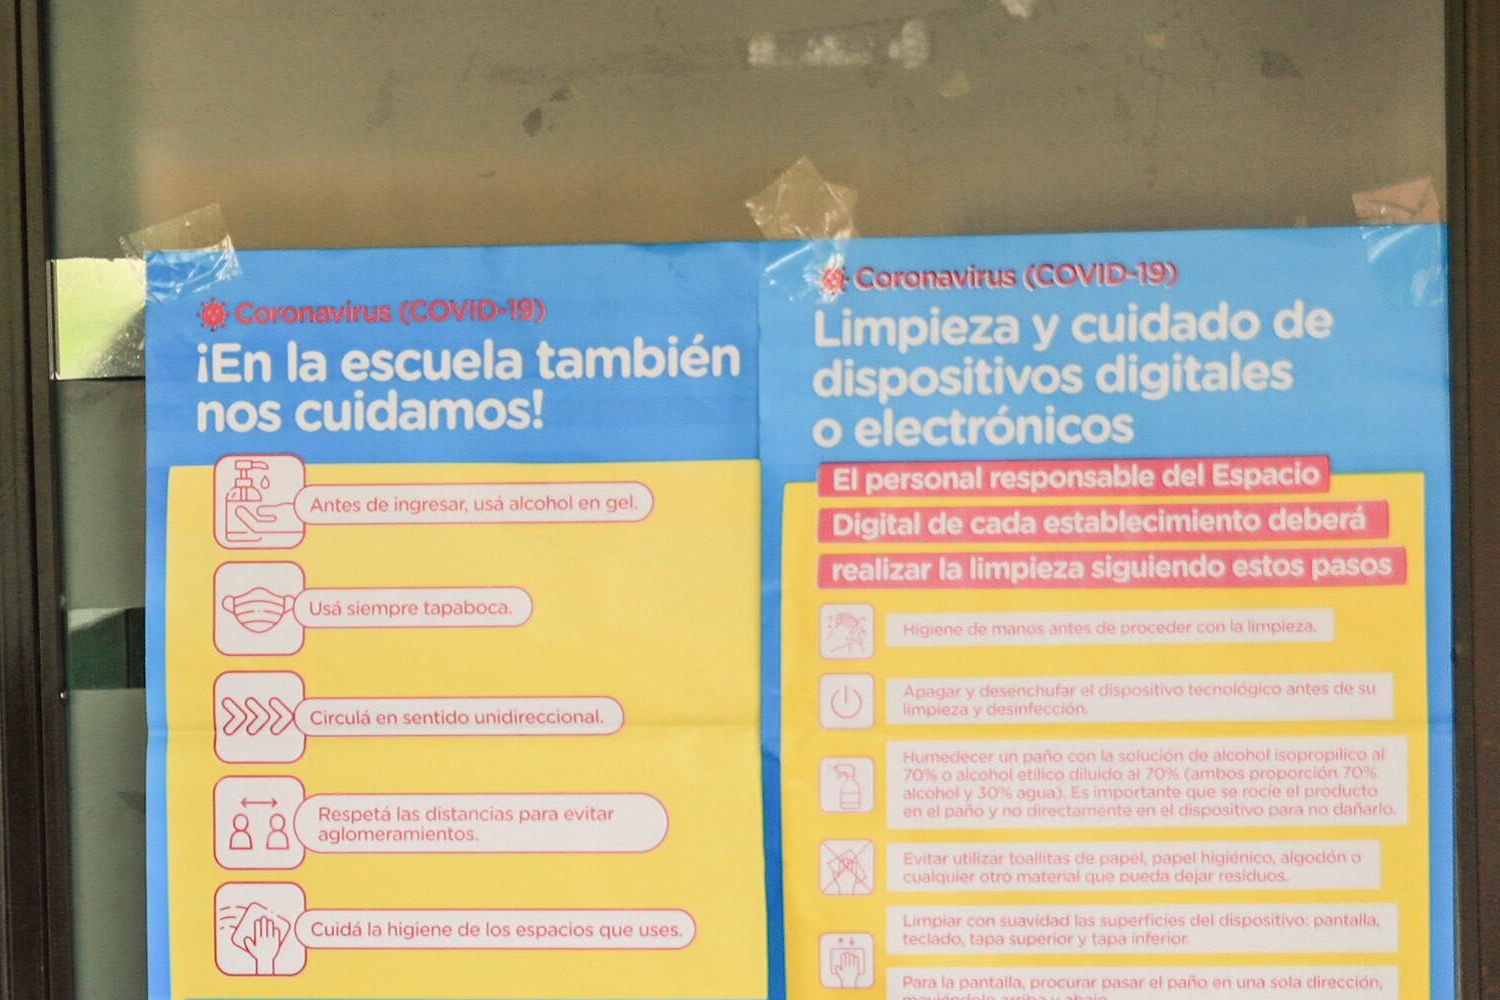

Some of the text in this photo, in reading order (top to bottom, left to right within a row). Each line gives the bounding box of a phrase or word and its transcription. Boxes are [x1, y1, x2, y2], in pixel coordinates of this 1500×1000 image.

[853, 261, 1178, 291] Coronavirus (COVID-19)
[234, 297, 546, 326] Coronavirus (COVID-19)
[814, 298, 1334, 353] Limpieza y cuidado de
[196, 332, 741, 384] ¡En la escuela también
[812, 351, 1294, 402] dispositivos digitales
[196, 388, 544, 433] nos cuidamos!
[812, 404, 1135, 449] o electrónicos
[833, 461, 1321, 497] El personal responsable del Espacio
[309, 494, 637, 516] Antes de ingresar, usá alcohol en gel.
[833, 505, 1367, 541] Digital de cada establecimiento deberá
[832, 553, 1393, 584] realizar la limpieza siguiendo estos pasos
[309, 599, 512, 619] Usá siempre tapaboca.
[903, 619, 1317, 639] Higiene de manos antes de proceder con la limpieza.
[903, 680, 1378, 701] Apagar y desenchufar el dispositivo tecnológico antes de su
[309, 709, 604, 726] Circulá en sentido unidireccional.
[903, 701, 1089, 719] limpieza y desinfección.
[318, 805, 615, 825] Respetá las distancias para evitar
[317, 826, 478, 845] aglomeramientos.
[310, 921, 682, 941] Cuidá la higiene de los espacios que uses.
[903, 912, 1380, 929] Limpiar con suavidad las superficies del dispositivo: pantalla,
[902, 931, 1189, 948] teclado, tapa superior y tapa inferior.
[902, 975, 1383, 991] Para la pantalla, procurar pasar el paño en una sola dirección,
